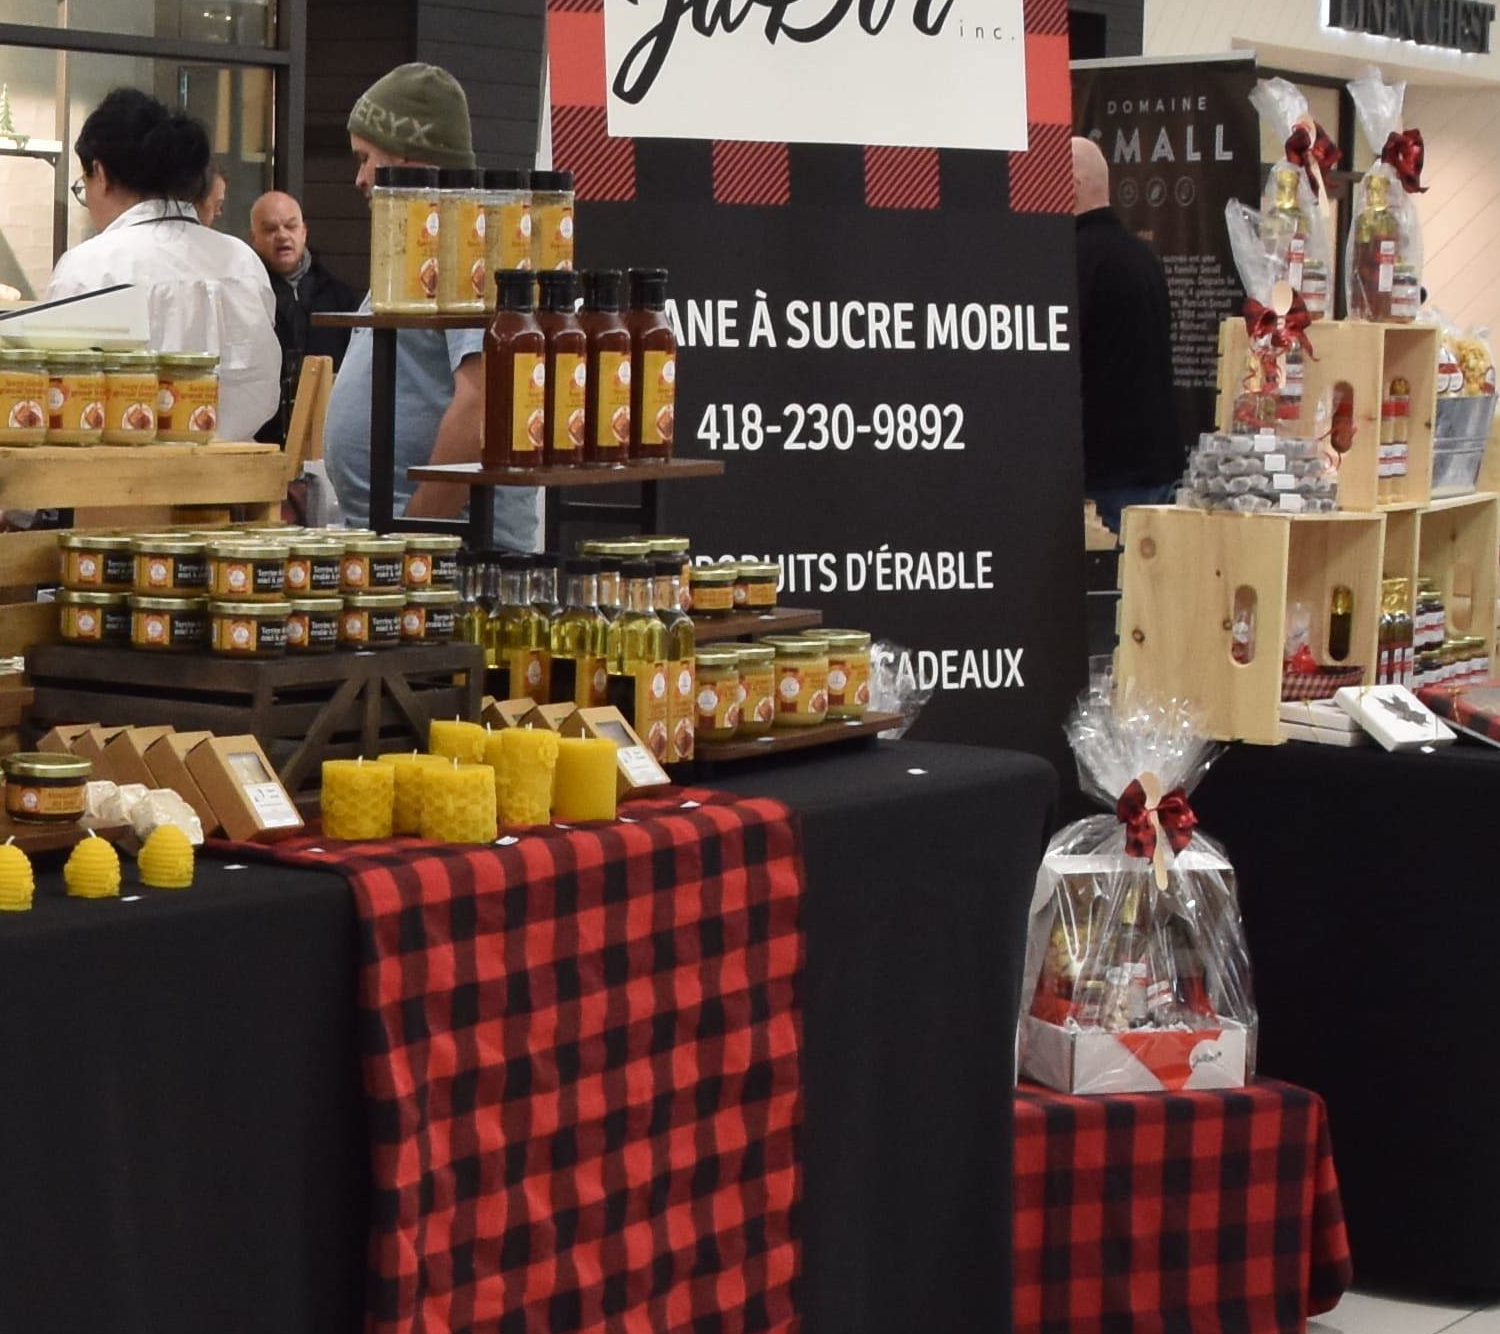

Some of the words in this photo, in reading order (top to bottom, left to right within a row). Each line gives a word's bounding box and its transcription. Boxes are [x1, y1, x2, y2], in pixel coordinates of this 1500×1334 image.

[958, 20, 1017, 42] inc.
[1107, 95, 1208, 115] DOMAINE
[749, 289, 776, 347] À
[787, 301, 915, 349] SUCRE
[927, 303, 1069, 350] MOBILE
[697, 404, 965, 450] 418-230-9892
